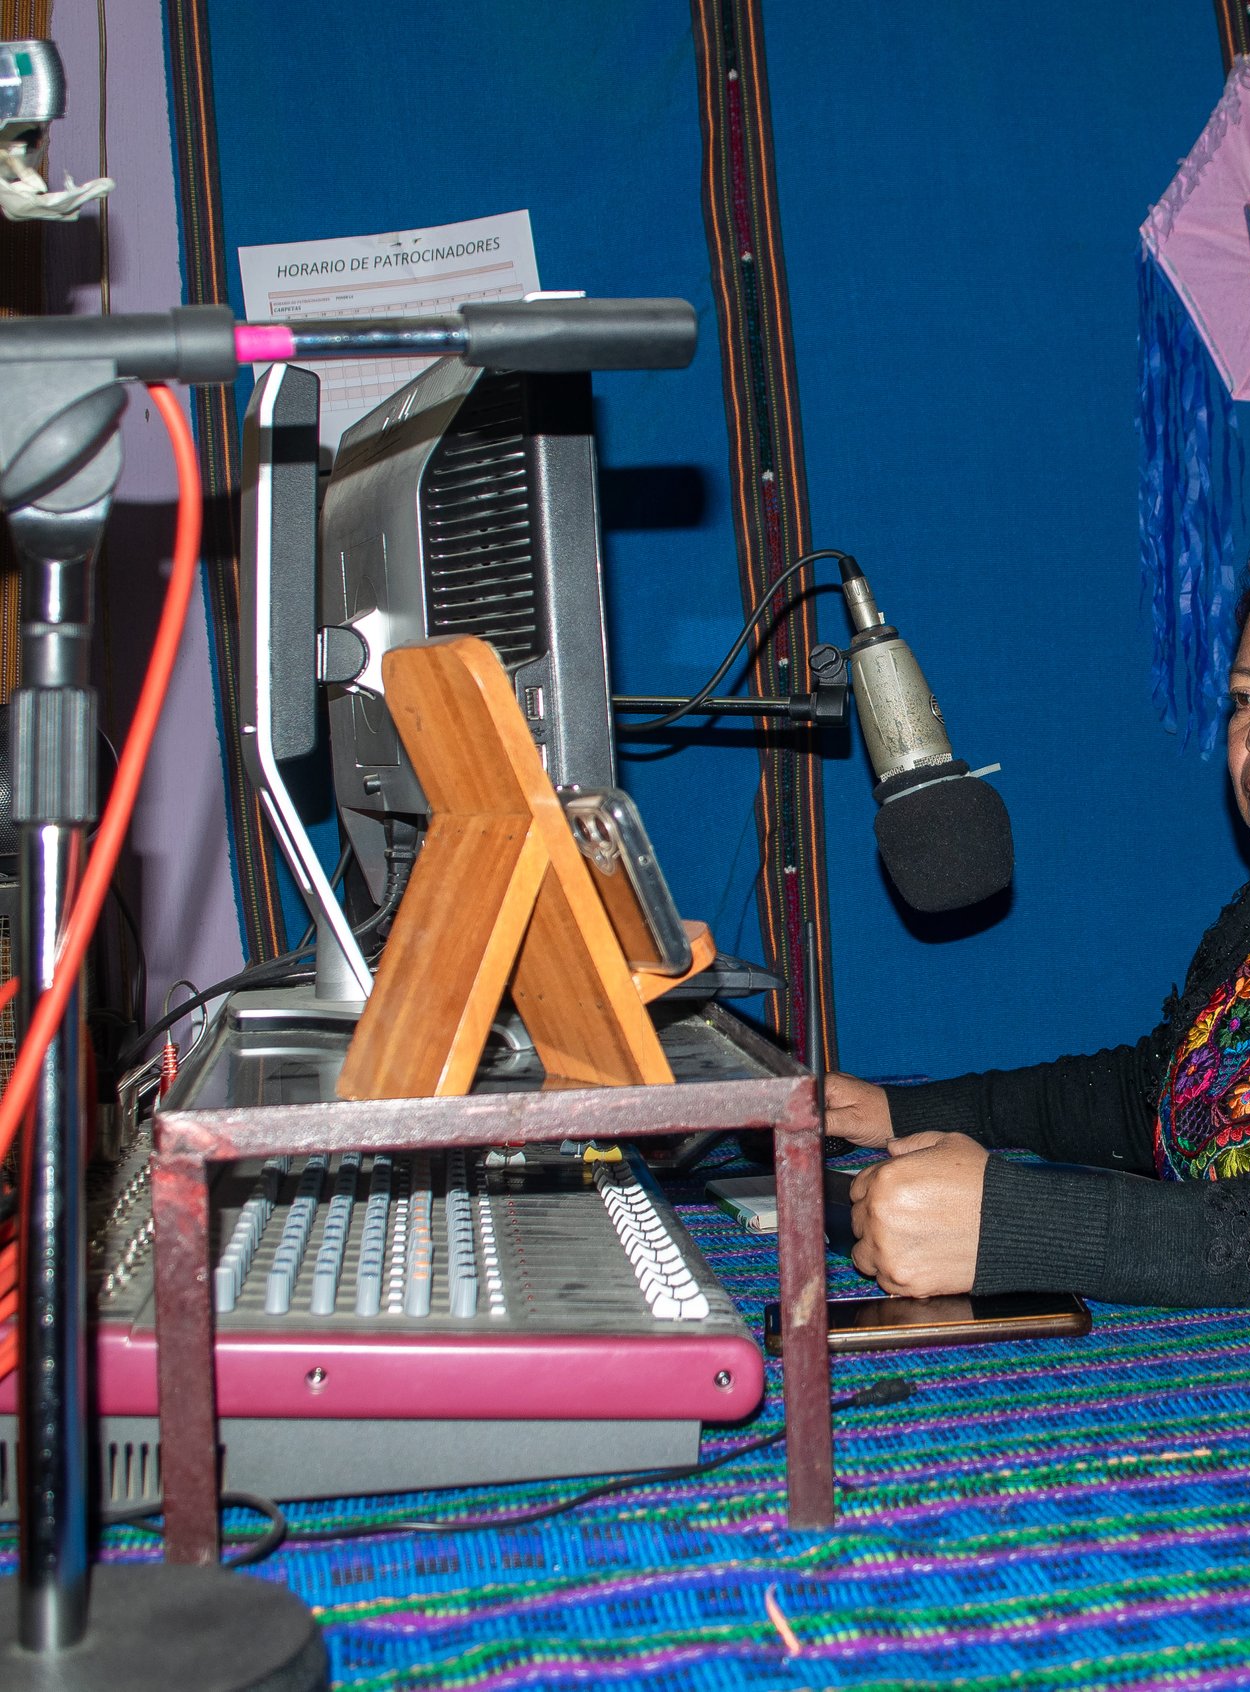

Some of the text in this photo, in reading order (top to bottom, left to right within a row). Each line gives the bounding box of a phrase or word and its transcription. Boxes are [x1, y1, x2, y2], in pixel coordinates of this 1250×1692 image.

[276, 236, 501, 279] HORARIO DE PATROCINADORES
